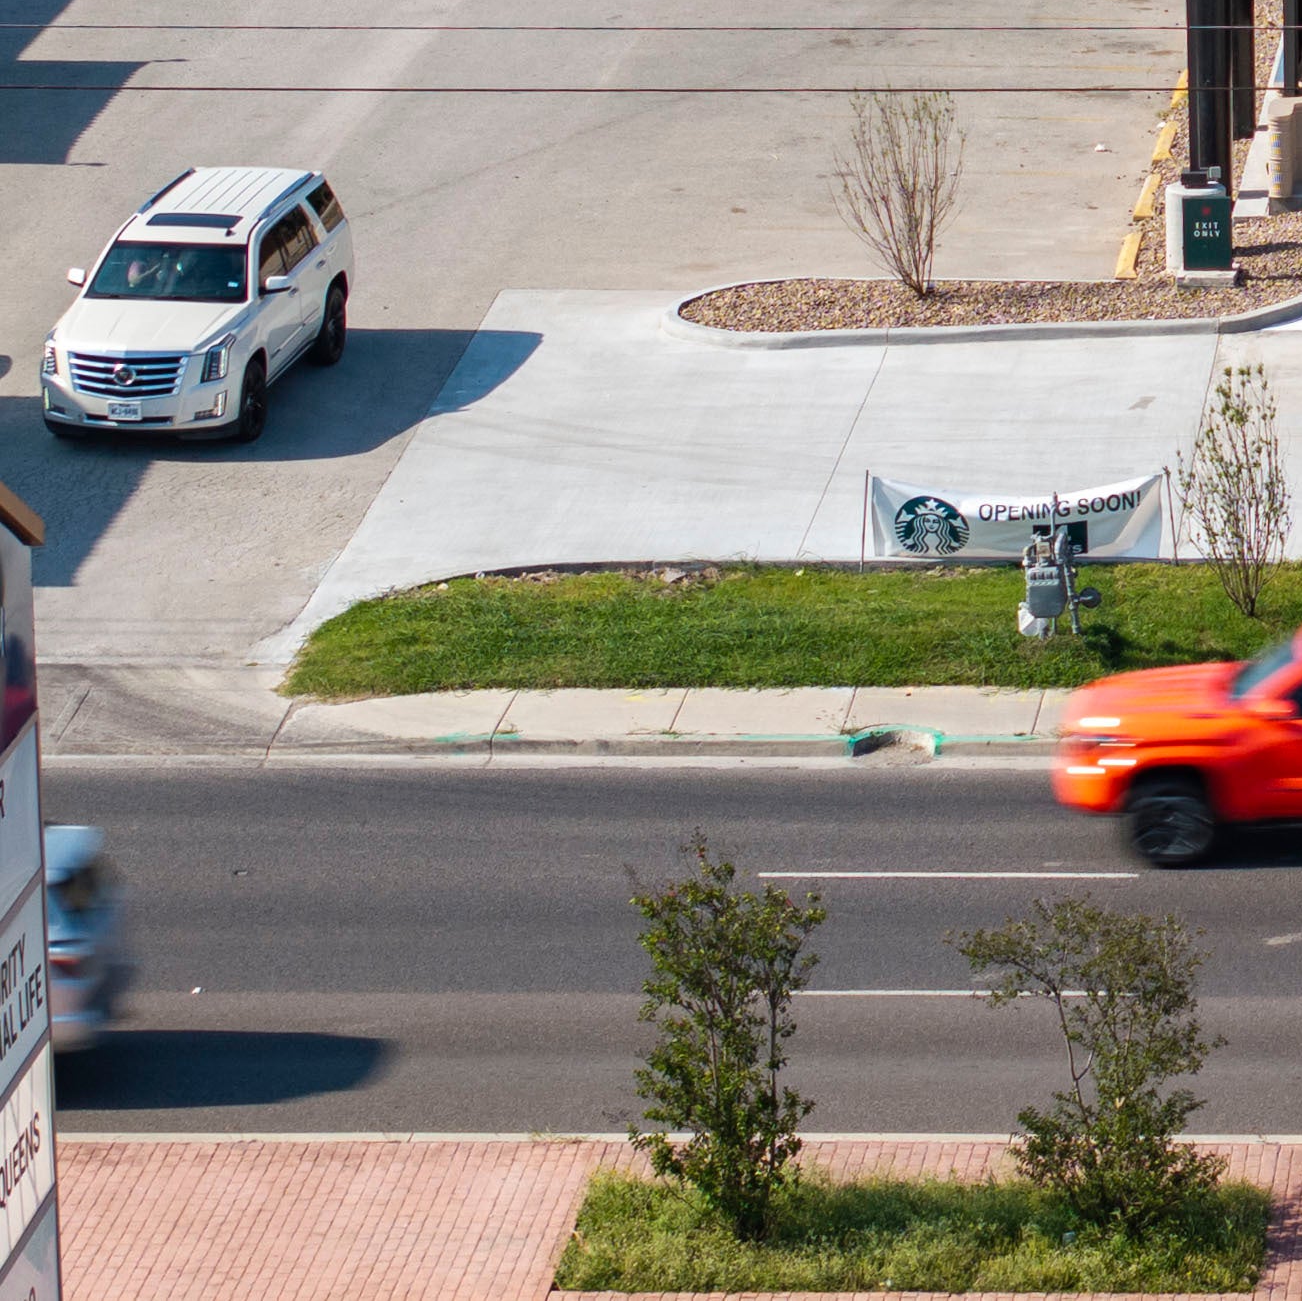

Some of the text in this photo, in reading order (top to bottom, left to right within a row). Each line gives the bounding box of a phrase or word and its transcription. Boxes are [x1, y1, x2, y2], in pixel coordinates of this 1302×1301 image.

[1193, 230, 1221, 238] ONLY
[1195, 221, 1219, 230] EXIT
[979, 491, 1141, 522] OPENING SOON!
[18, 963, 43, 1029] LIFE
